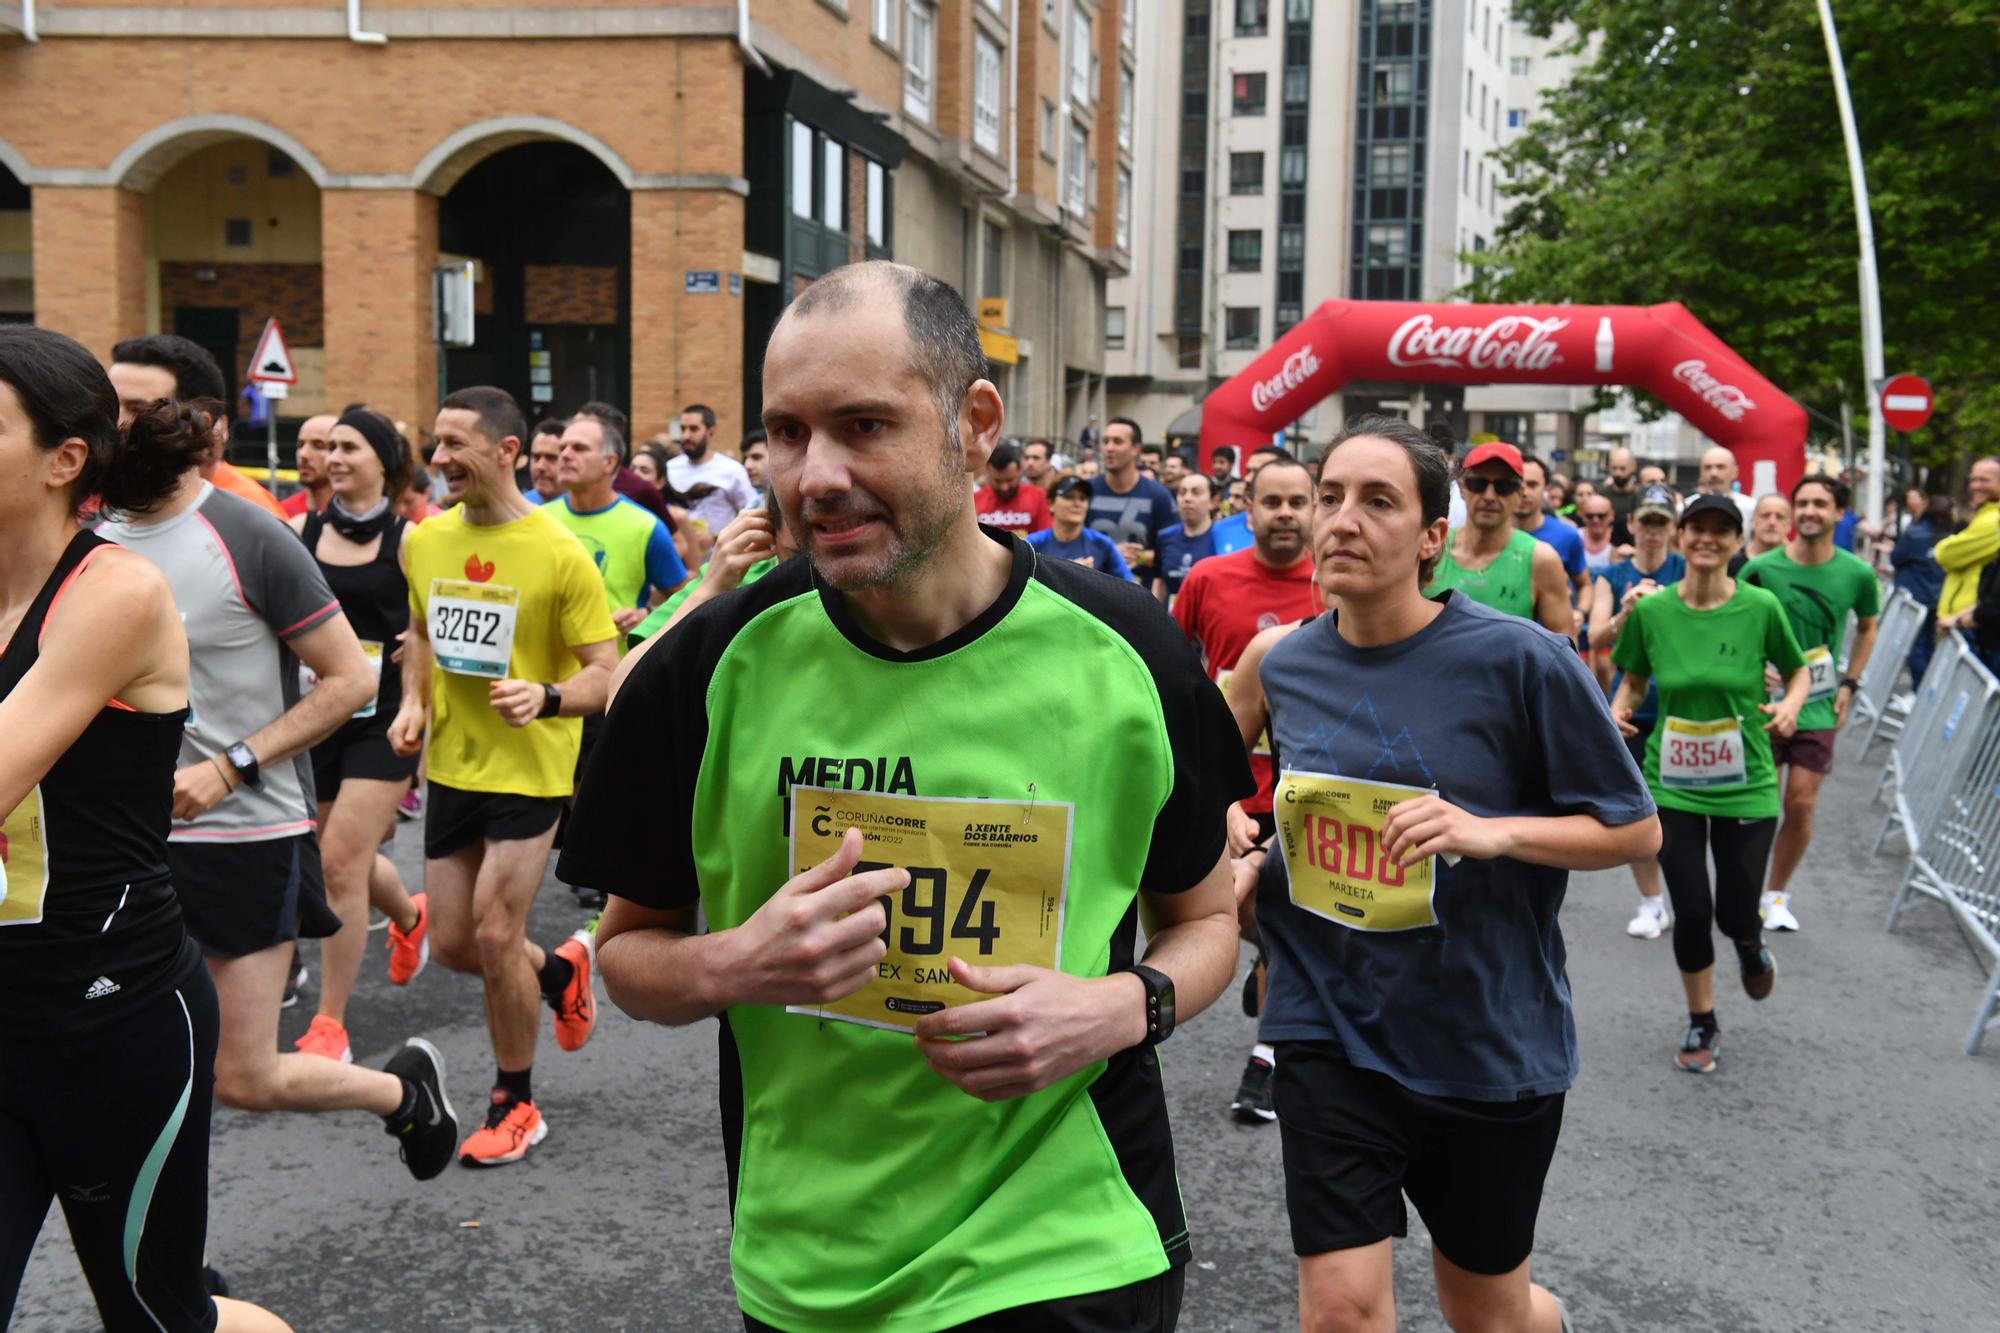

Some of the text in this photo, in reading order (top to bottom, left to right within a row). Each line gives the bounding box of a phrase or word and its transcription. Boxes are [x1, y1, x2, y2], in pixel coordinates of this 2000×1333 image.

[1387, 313, 1571, 369] Coca-Cola
[977, 509, 1032, 526] adidas
[436, 606, 501, 646] 3262
[1669, 739, 1733, 767] 3354
[777, 756, 917, 796] MEDIA
[836, 809, 927, 829] CORUÑACORRE
[964, 823, 1012, 833] A XENTE
[881, 834, 904, 845] 2022
[963, 832, 1038, 843] DOS BARRIOS
[1329, 879, 1375, 902] MARIETA
[913, 967, 957, 984] SAN
[85, 984, 121, 1000] adidas
